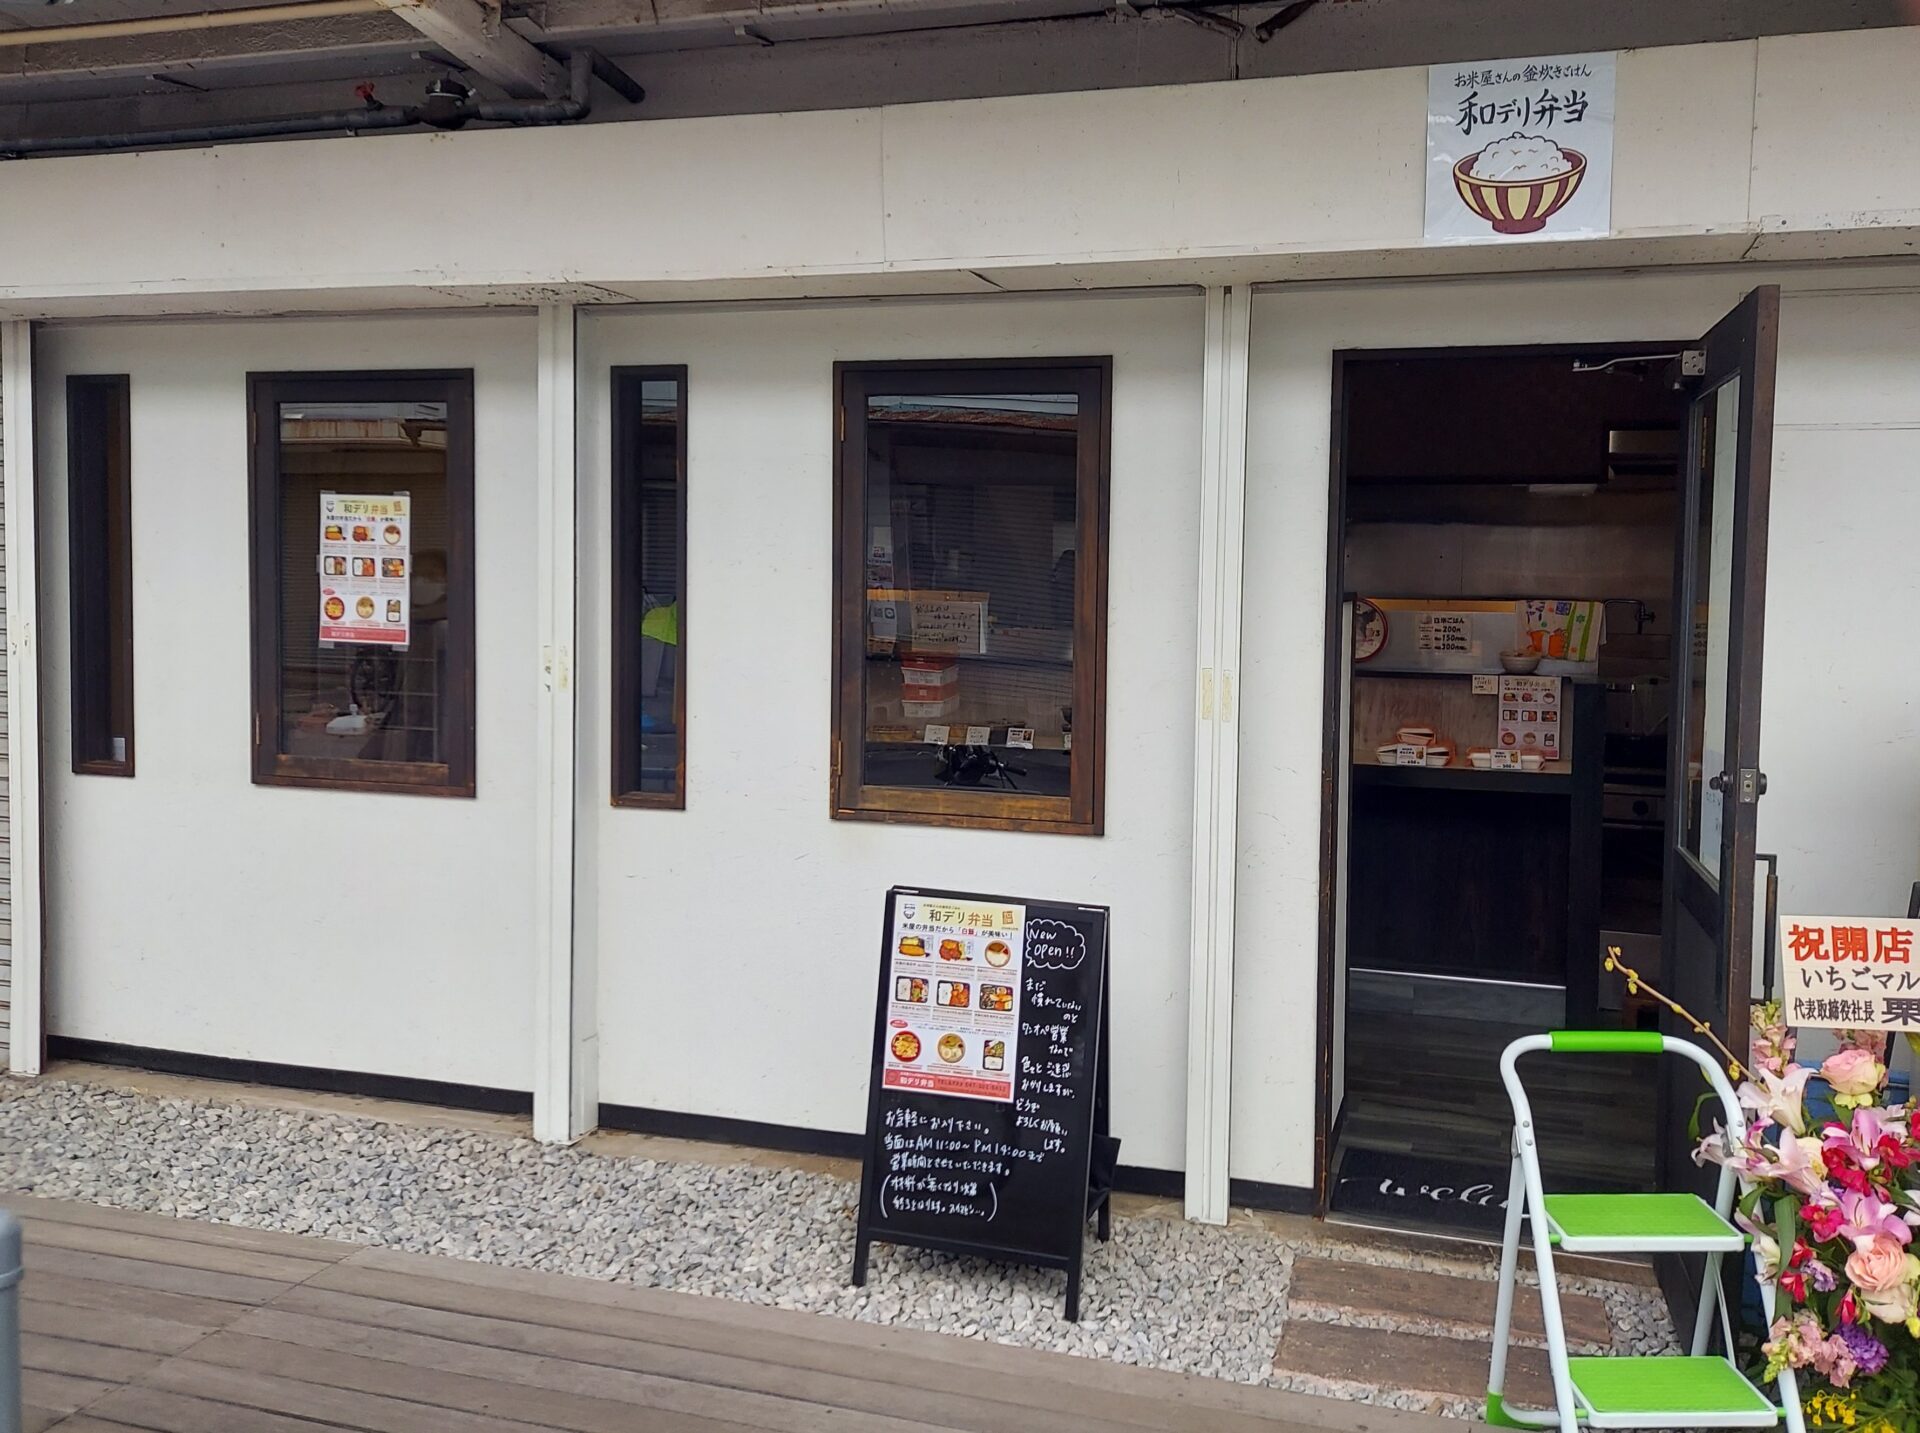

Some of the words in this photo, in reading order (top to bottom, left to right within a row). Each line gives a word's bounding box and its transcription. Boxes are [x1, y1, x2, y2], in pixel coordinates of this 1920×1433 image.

[1454, 63, 1592, 88] お米屋さんの釜炊きごはん
[1455, 88, 1589, 135] 和デリ弁当
[928, 908, 994, 927] 和デリ弁当
[1029, 928, 1057, 940] New
[1788, 924, 1913, 964] 祝開店
[1025, 976, 1046, 992] まだ
[1800, 966, 1920, 991] いちごマル
[1063, 1012, 1079, 1024] のと
[1793, 997, 1875, 1023] 代表取締役社長
[1021, 1022, 1069, 1044] ワンオペ営業
[1049, 1044, 1074, 1057] なので
[899, 1076, 934, 1088] 和デリ弁当
[1015, 1098, 1041, 1113] どうぞ
[1015, 1115, 1069, 1137] よろしくお願い
